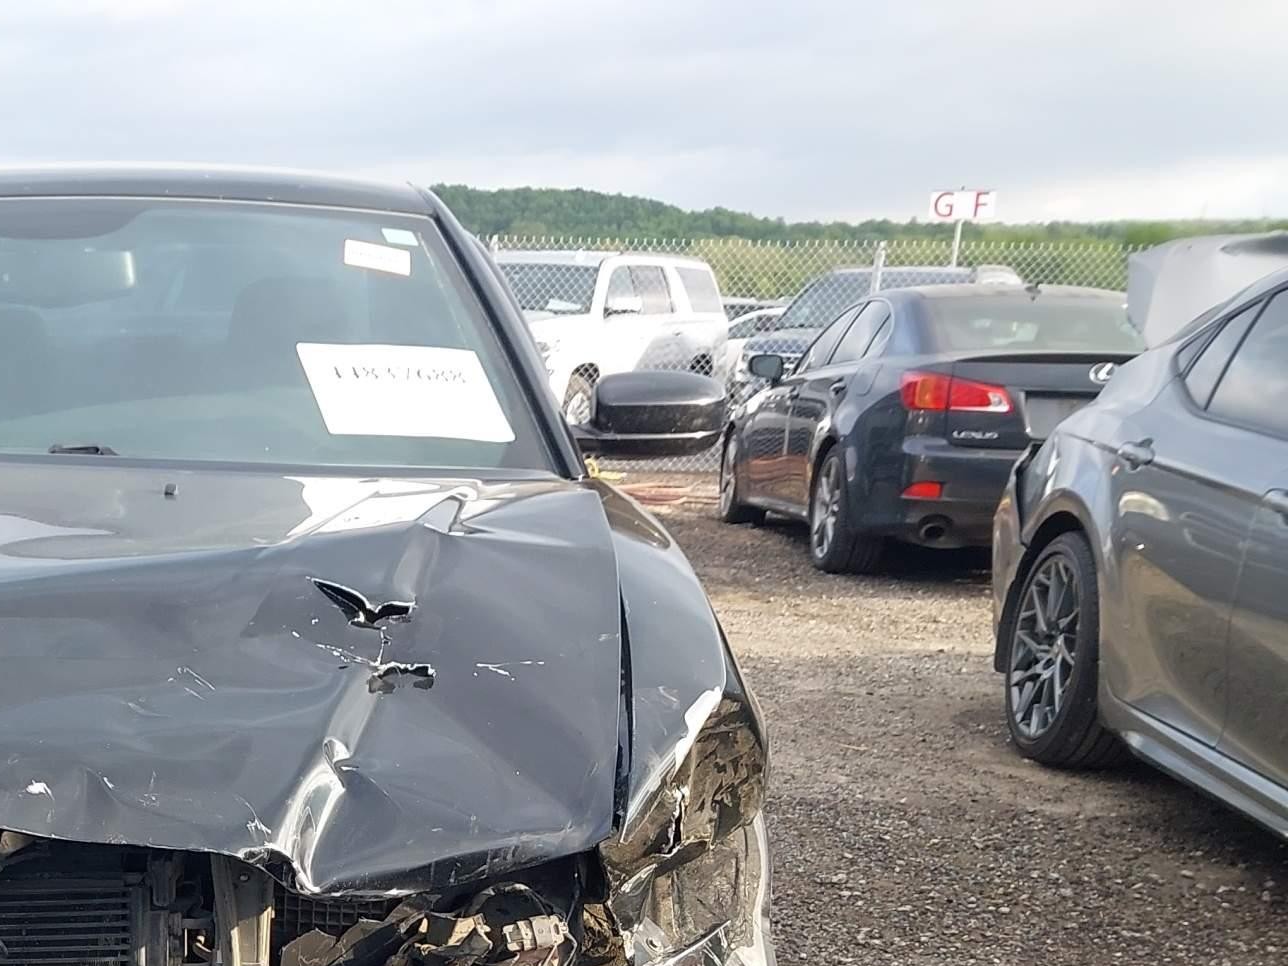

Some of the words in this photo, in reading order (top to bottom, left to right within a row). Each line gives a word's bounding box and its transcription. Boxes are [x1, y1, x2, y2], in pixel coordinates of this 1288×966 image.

[934, 191, 955, 217] G
[973, 191, 990, 217] F
[952, 430, 999, 439] LEXUS
